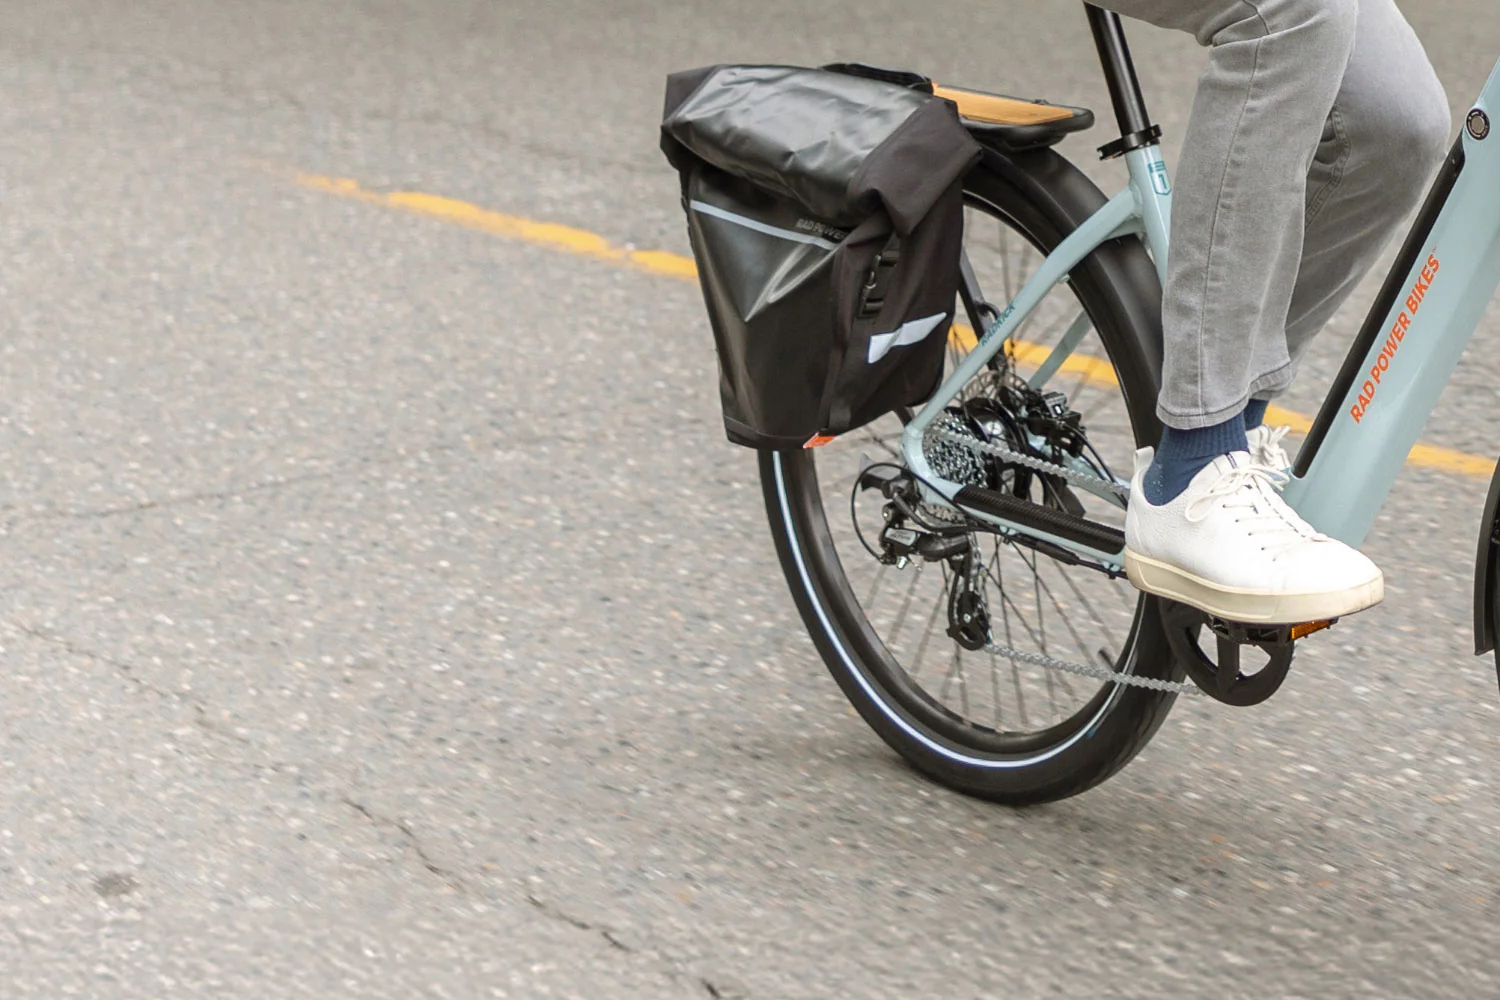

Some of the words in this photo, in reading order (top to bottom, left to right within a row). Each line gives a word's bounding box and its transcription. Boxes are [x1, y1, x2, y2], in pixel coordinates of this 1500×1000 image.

[1350, 380, 1376, 424] RAD
[1370, 311, 1411, 384] POWER
[1405, 254, 1440, 315] BIKES
